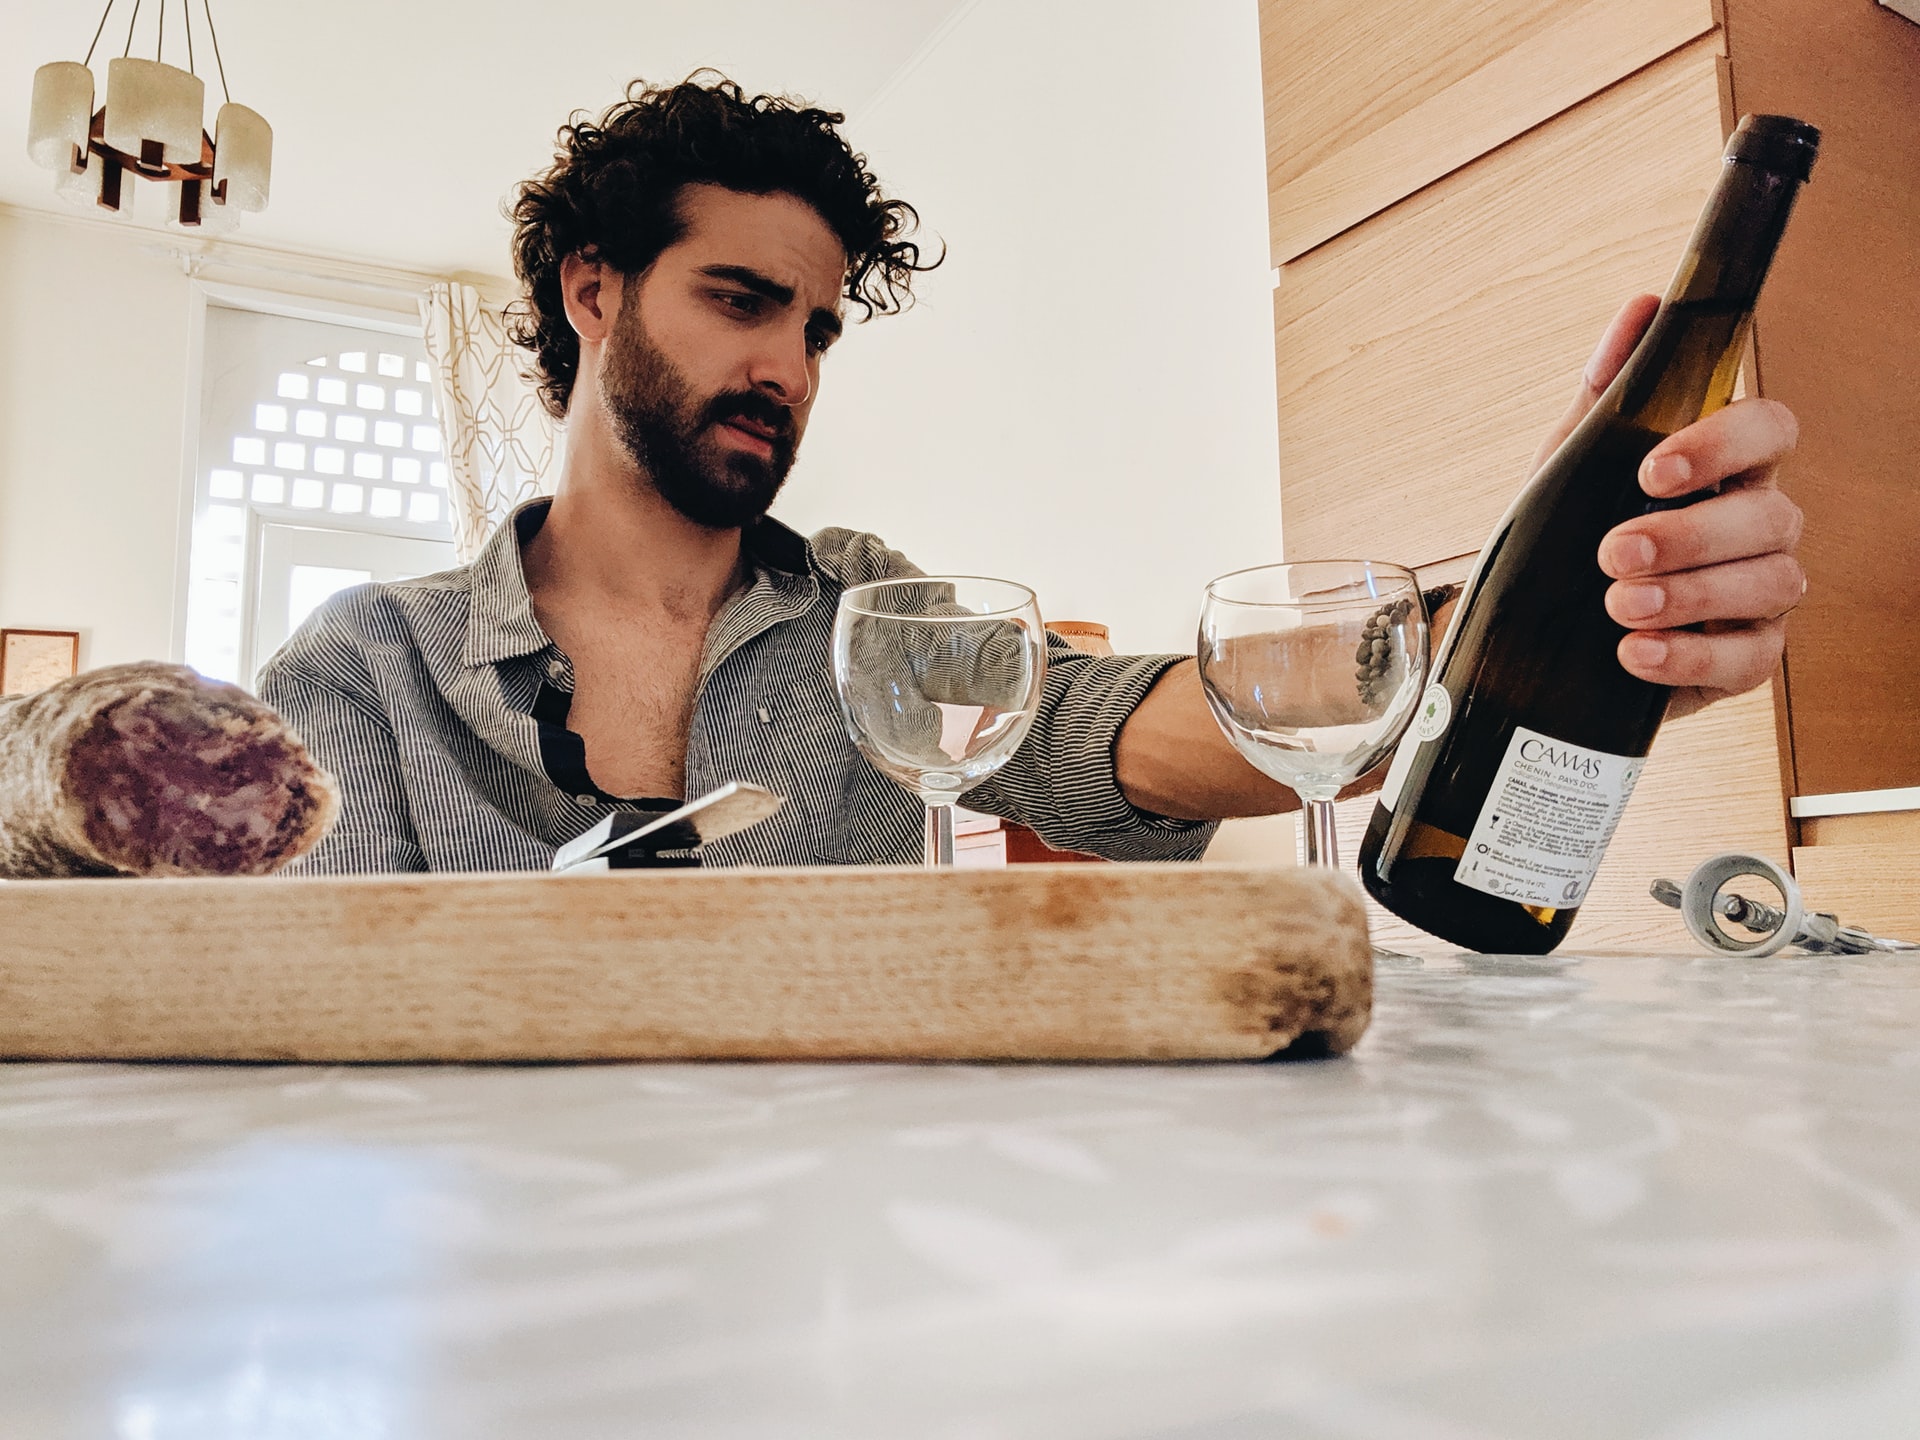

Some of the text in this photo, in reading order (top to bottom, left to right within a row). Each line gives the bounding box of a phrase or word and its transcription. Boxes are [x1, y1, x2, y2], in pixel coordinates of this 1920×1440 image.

[1514, 760, 1551, 778] CHENIN
[1558, 775, 1579, 786] PAYS
[1579, 781, 1598, 791] D'OC
[1520, 739, 1602, 779] CAMAS
